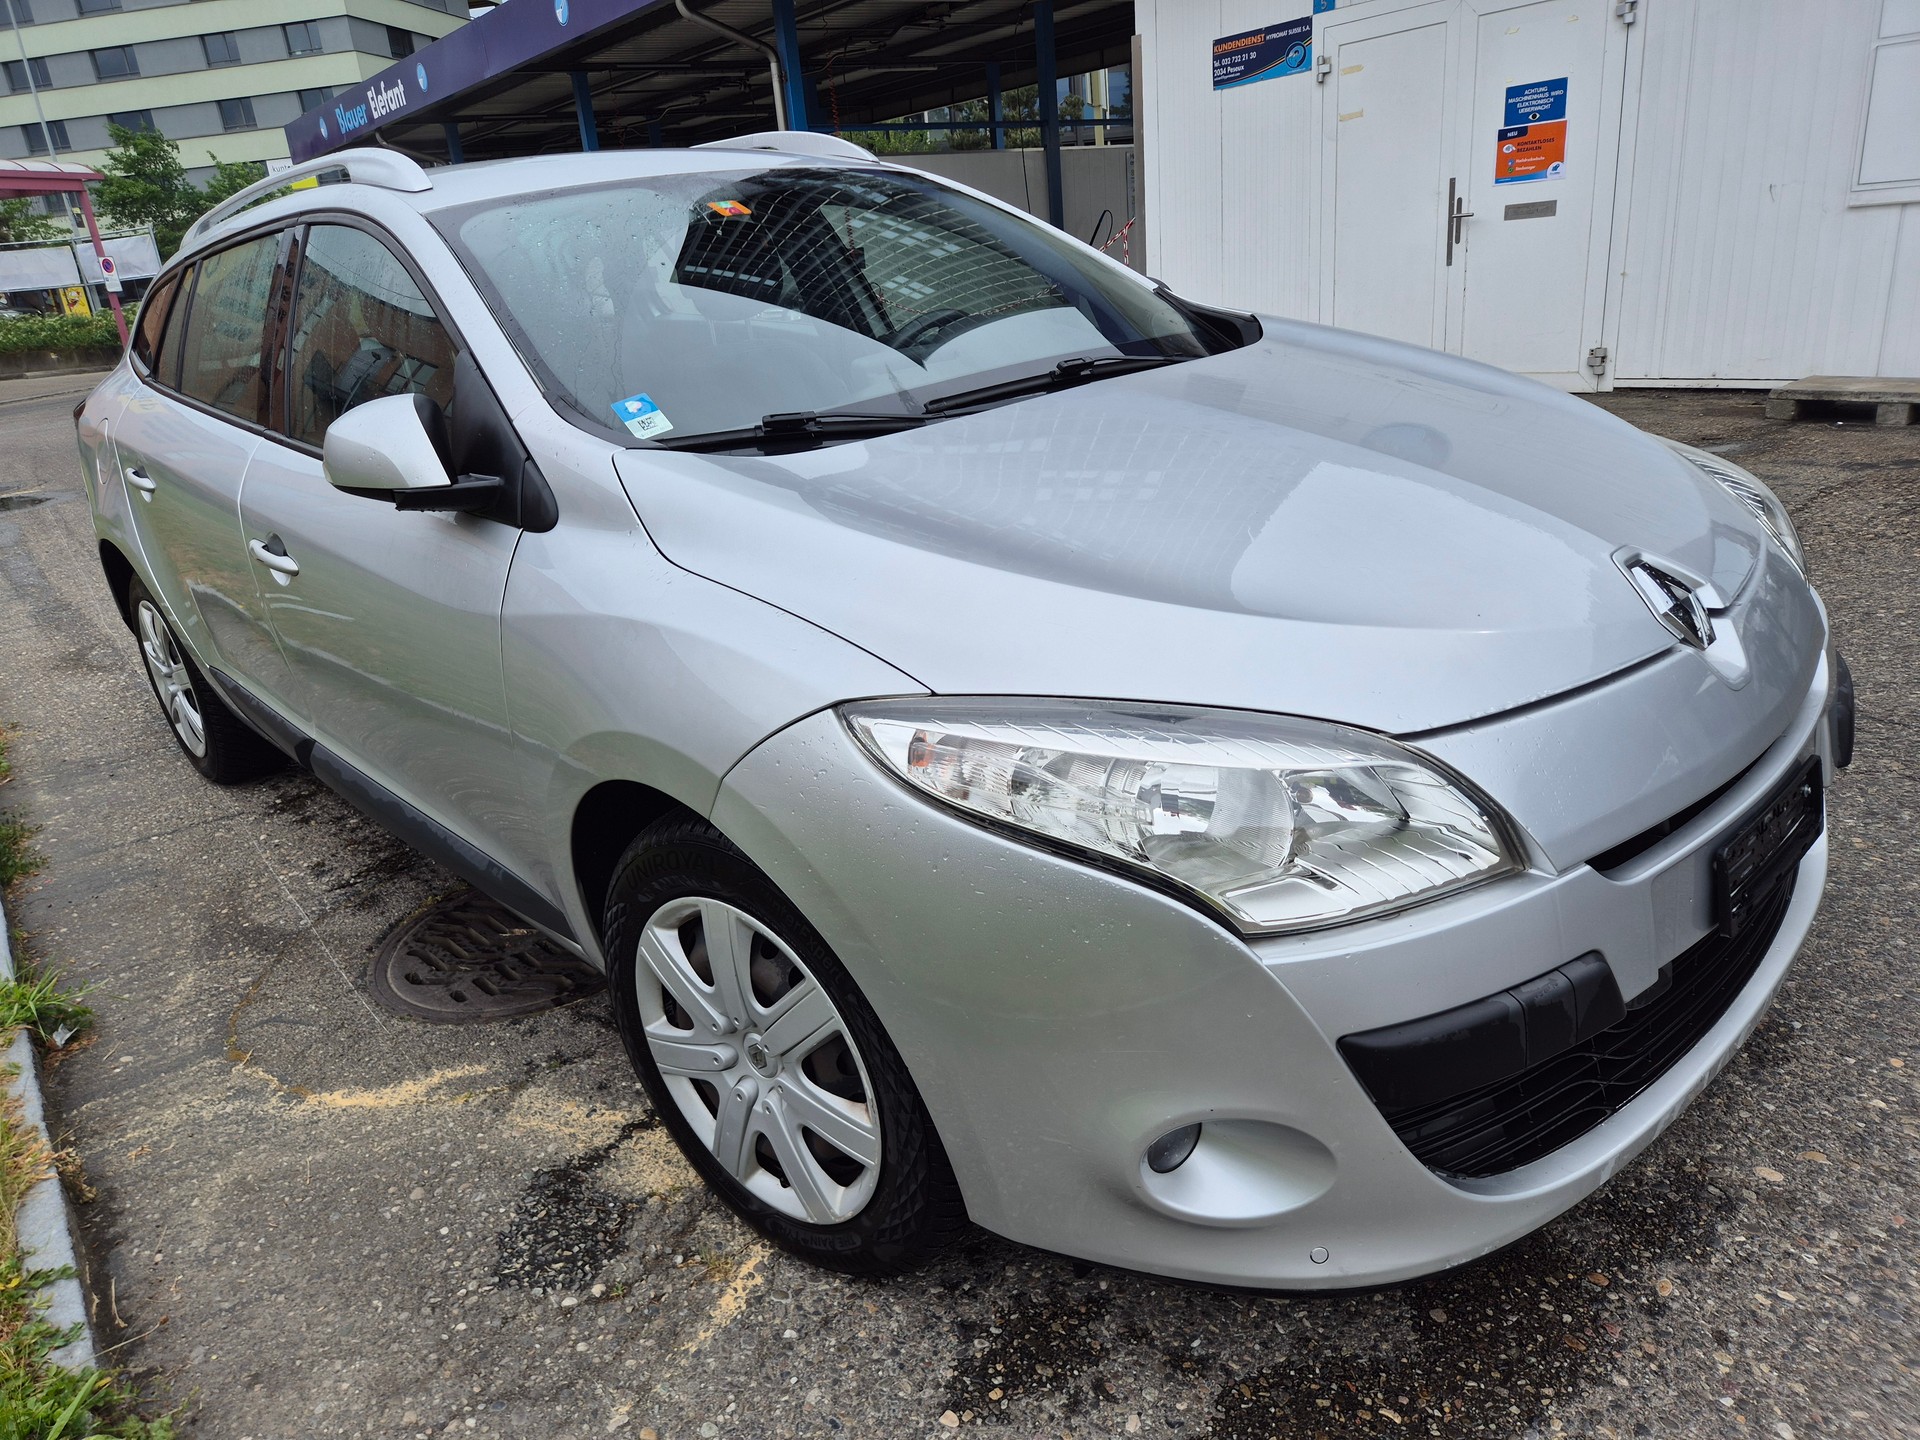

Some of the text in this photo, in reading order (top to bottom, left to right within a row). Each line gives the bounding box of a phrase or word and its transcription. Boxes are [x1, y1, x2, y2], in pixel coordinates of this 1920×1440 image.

[1213, 34, 1265, 53] KUNDENDIENST
[1242, 53, 1249, 61] 21
[1249, 51, 1257, 60] 30
[1524, 86, 1548, 95] ACHTUNG
[1508, 92, 1549, 104] MASCHINENHAUS
[1516, 97, 1554, 109] ELEKTRONISCH
[335, 79, 407, 135] Blauer Elefant
[1518, 104, 1551, 114] UEBERWACHT
[1516, 137, 1555, 147] KONTAKTLOSES
[1516, 145, 1542, 153] BEZAHLEN
